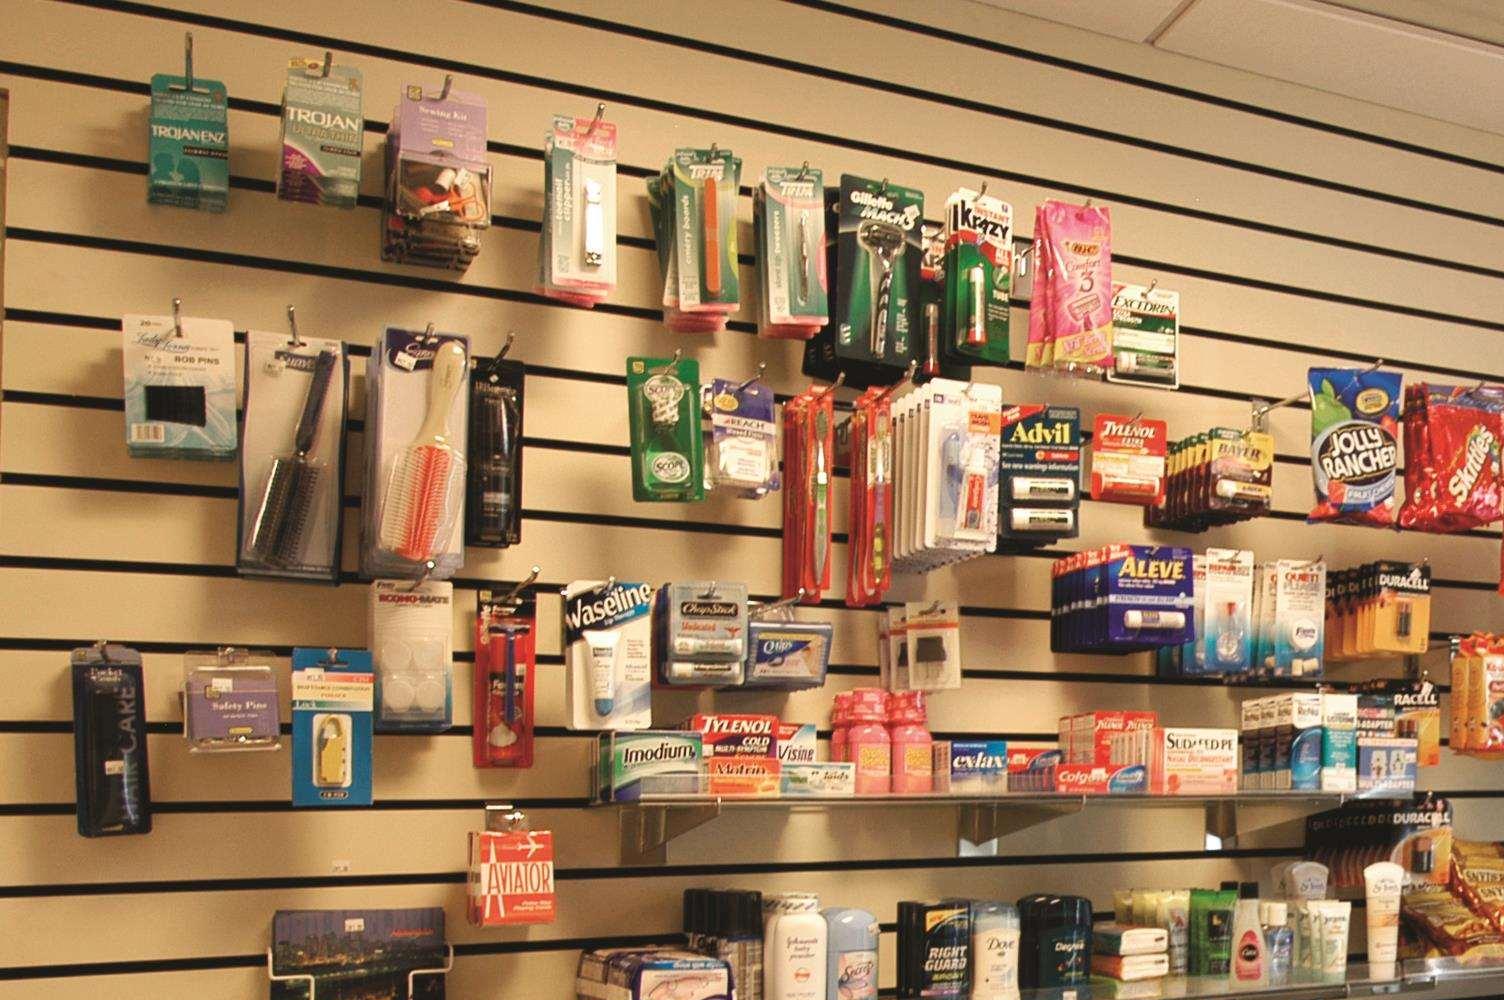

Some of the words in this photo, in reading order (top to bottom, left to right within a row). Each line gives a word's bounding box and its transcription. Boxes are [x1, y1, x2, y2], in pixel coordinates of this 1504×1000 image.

[286, 106, 360, 131] TROJAN
[850, 191, 893, 211] Gillette
[682, 194, 691, 230] boards
[860, 205, 915, 230] MACH3
[1080, 270, 1094, 292] 3
[1113, 296, 1175, 313] EXCEDRIN
[730, 417, 766, 431] REACH
[1009, 420, 1071, 445] Advil
[1101, 419, 1157, 439] TYLENOL
[1331, 427, 1384, 458] JOLLY
[1322, 447, 1397, 481] RANCHER
[1449, 424, 1494, 507] Skittles
[1118, 555, 1185, 579] ALEVE
[1378, 573, 1429, 590] DURACELL
[565, 584, 652, 630] Vaseline
[211, 701, 243, 713] Safety
[245, 701, 268, 712] Pins
[1393, 693, 1438, 706] RACELL
[701, 716, 773, 736] TYLENOL
[742, 736, 770, 747] COLD
[1221, 738, 1234, 751] PE
[623, 741, 691, 763] Imodium
[777, 744, 814, 761] Visine
[1392, 812, 1451, 825] DURACLL
[928, 945, 967, 959] RIGHT
[985, 936, 1016, 952] Dove
[923, 957, 967, 973] GUARD
